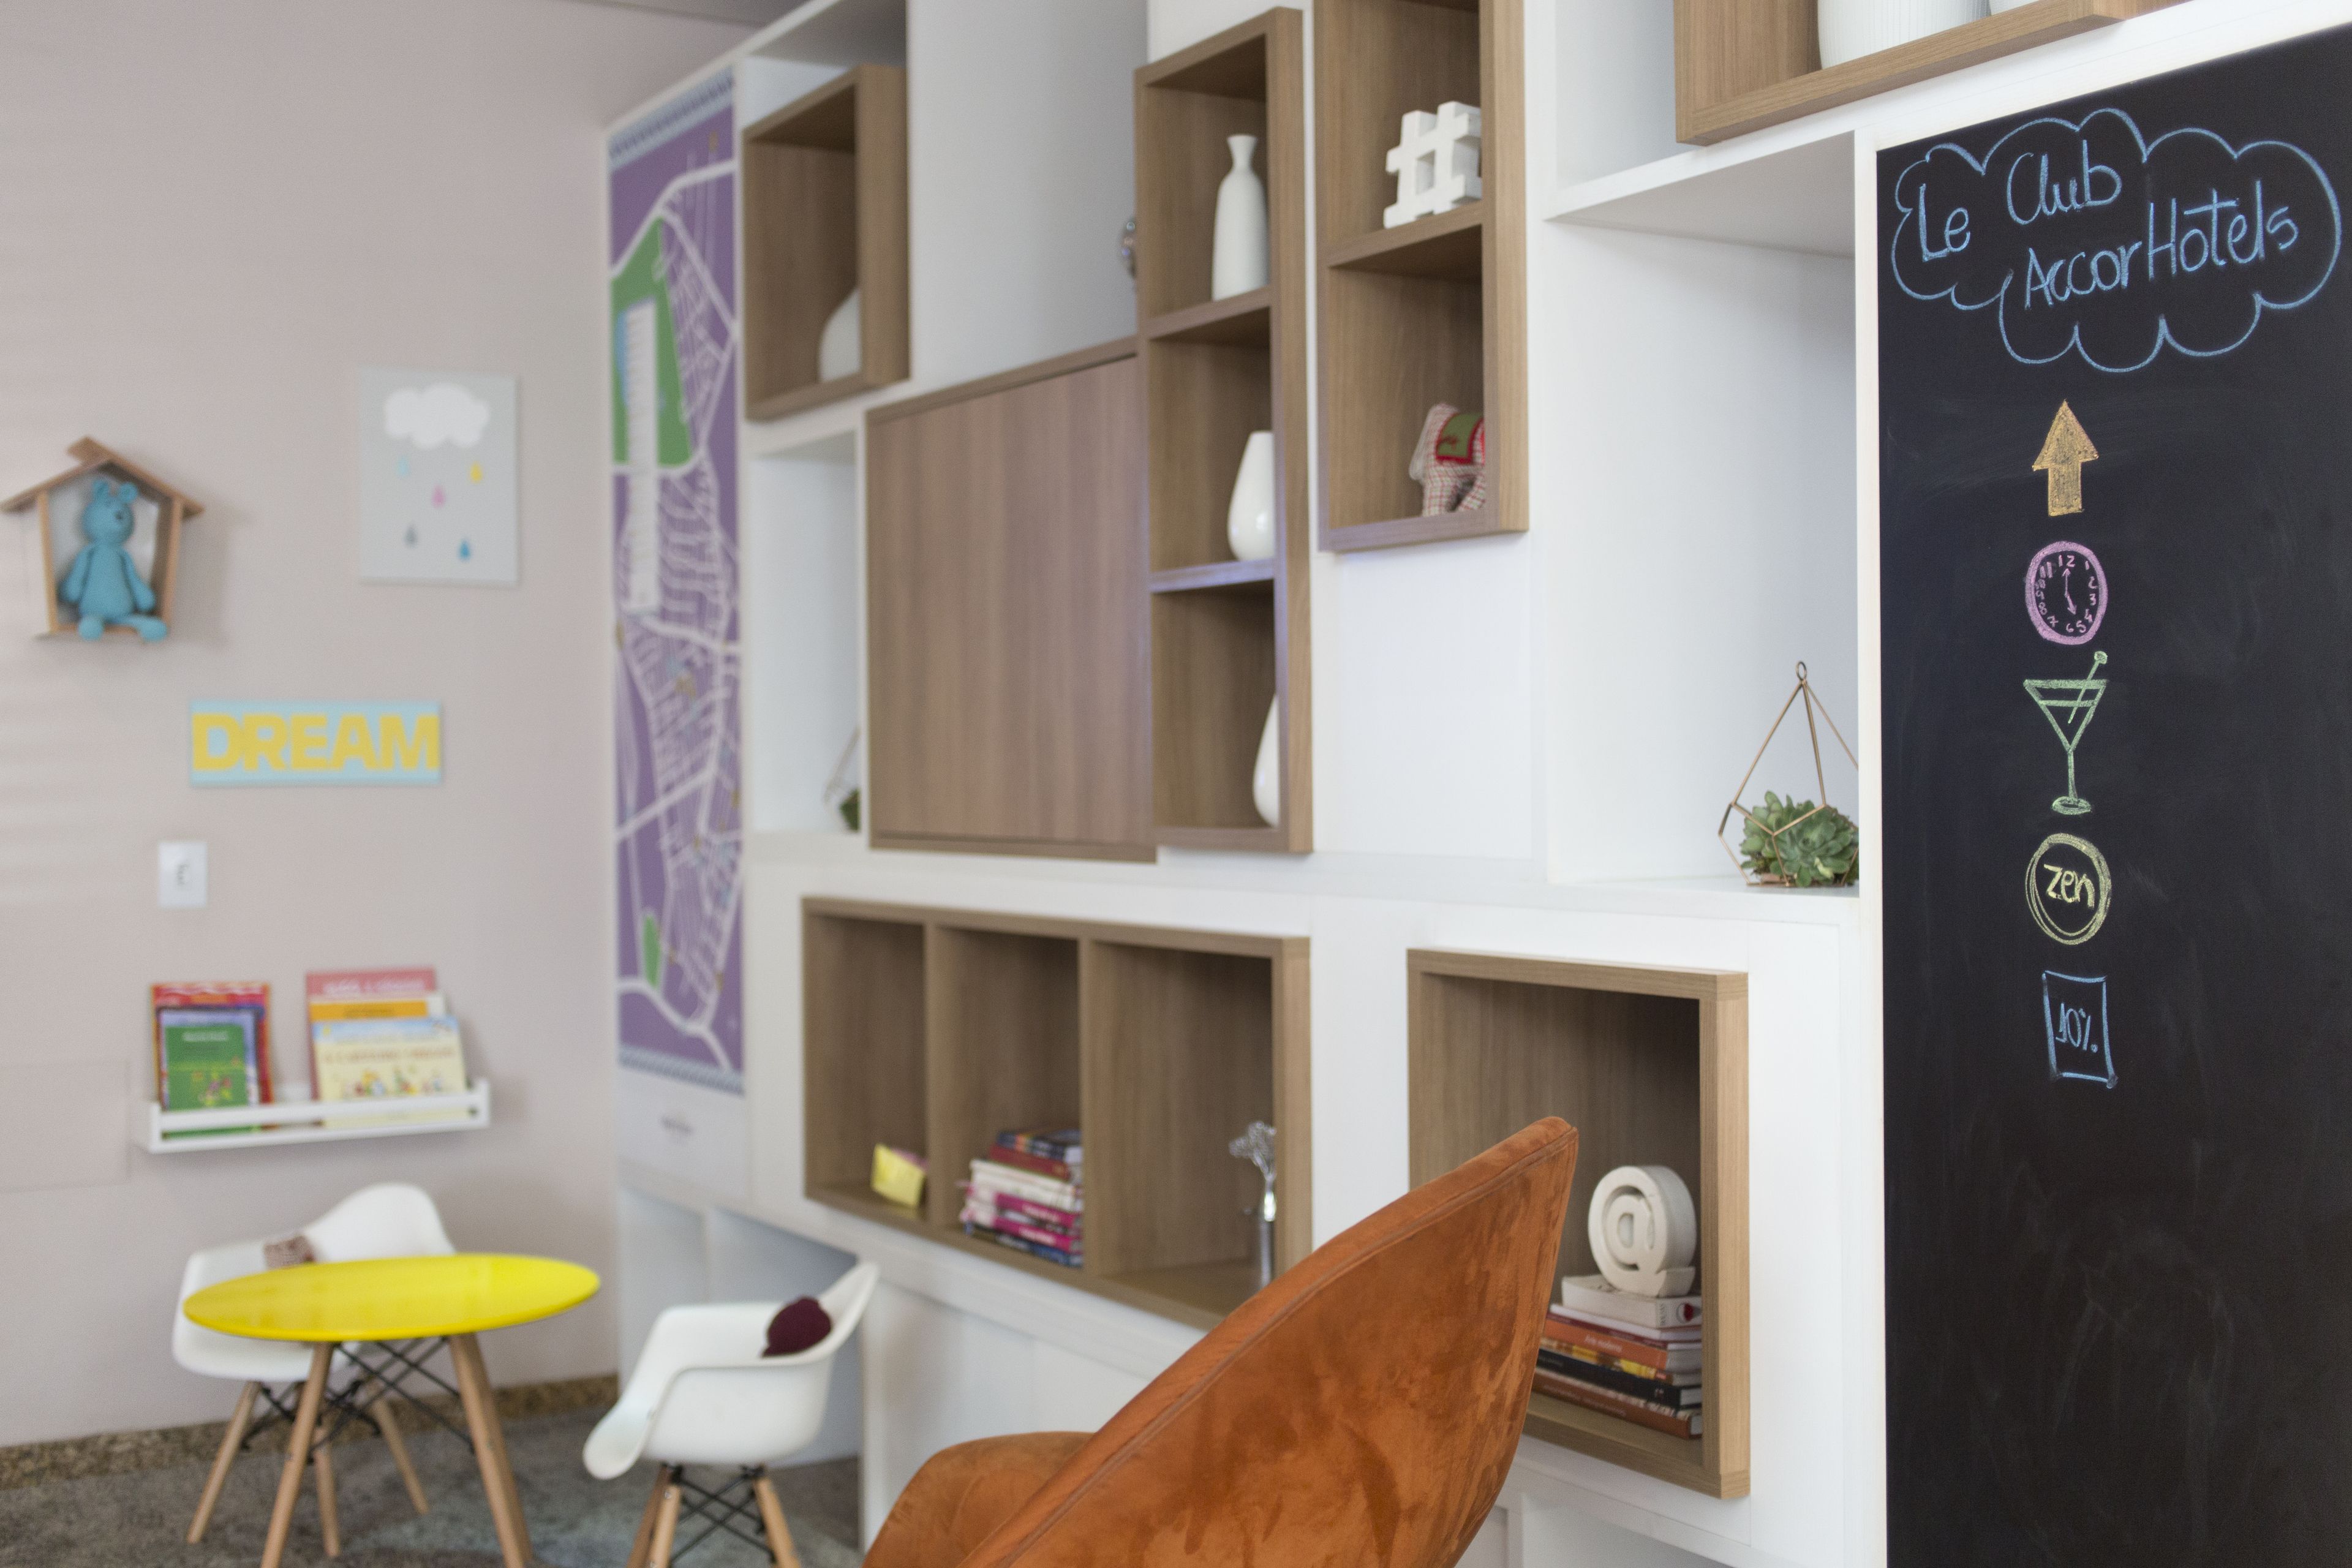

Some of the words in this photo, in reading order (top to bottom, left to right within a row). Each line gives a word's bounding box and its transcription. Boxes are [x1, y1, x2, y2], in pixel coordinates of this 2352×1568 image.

[1918, 183, 1971, 262] Le
[2006, 139, 2122, 225] Club
[2025, 180, 2299, 311] AccorHotels
[2058, 554, 2076, 567] 12
[2039, 562, 2052, 578] 11
[2088, 576, 2098, 589] 2
[2035, 590, 2045, 600] 9
[2089, 593, 2097, 606] 3
[2038, 601, 2048, 615] 8
[2047, 615, 2059, 627] 7
[2084, 608, 2093, 623] 4
[2065, 623, 2074, 633] 6
[2076, 620, 2086, 633] 5
[192, 713, 440, 771] DREAM
[2056, 1002, 2098, 1054] 10%
